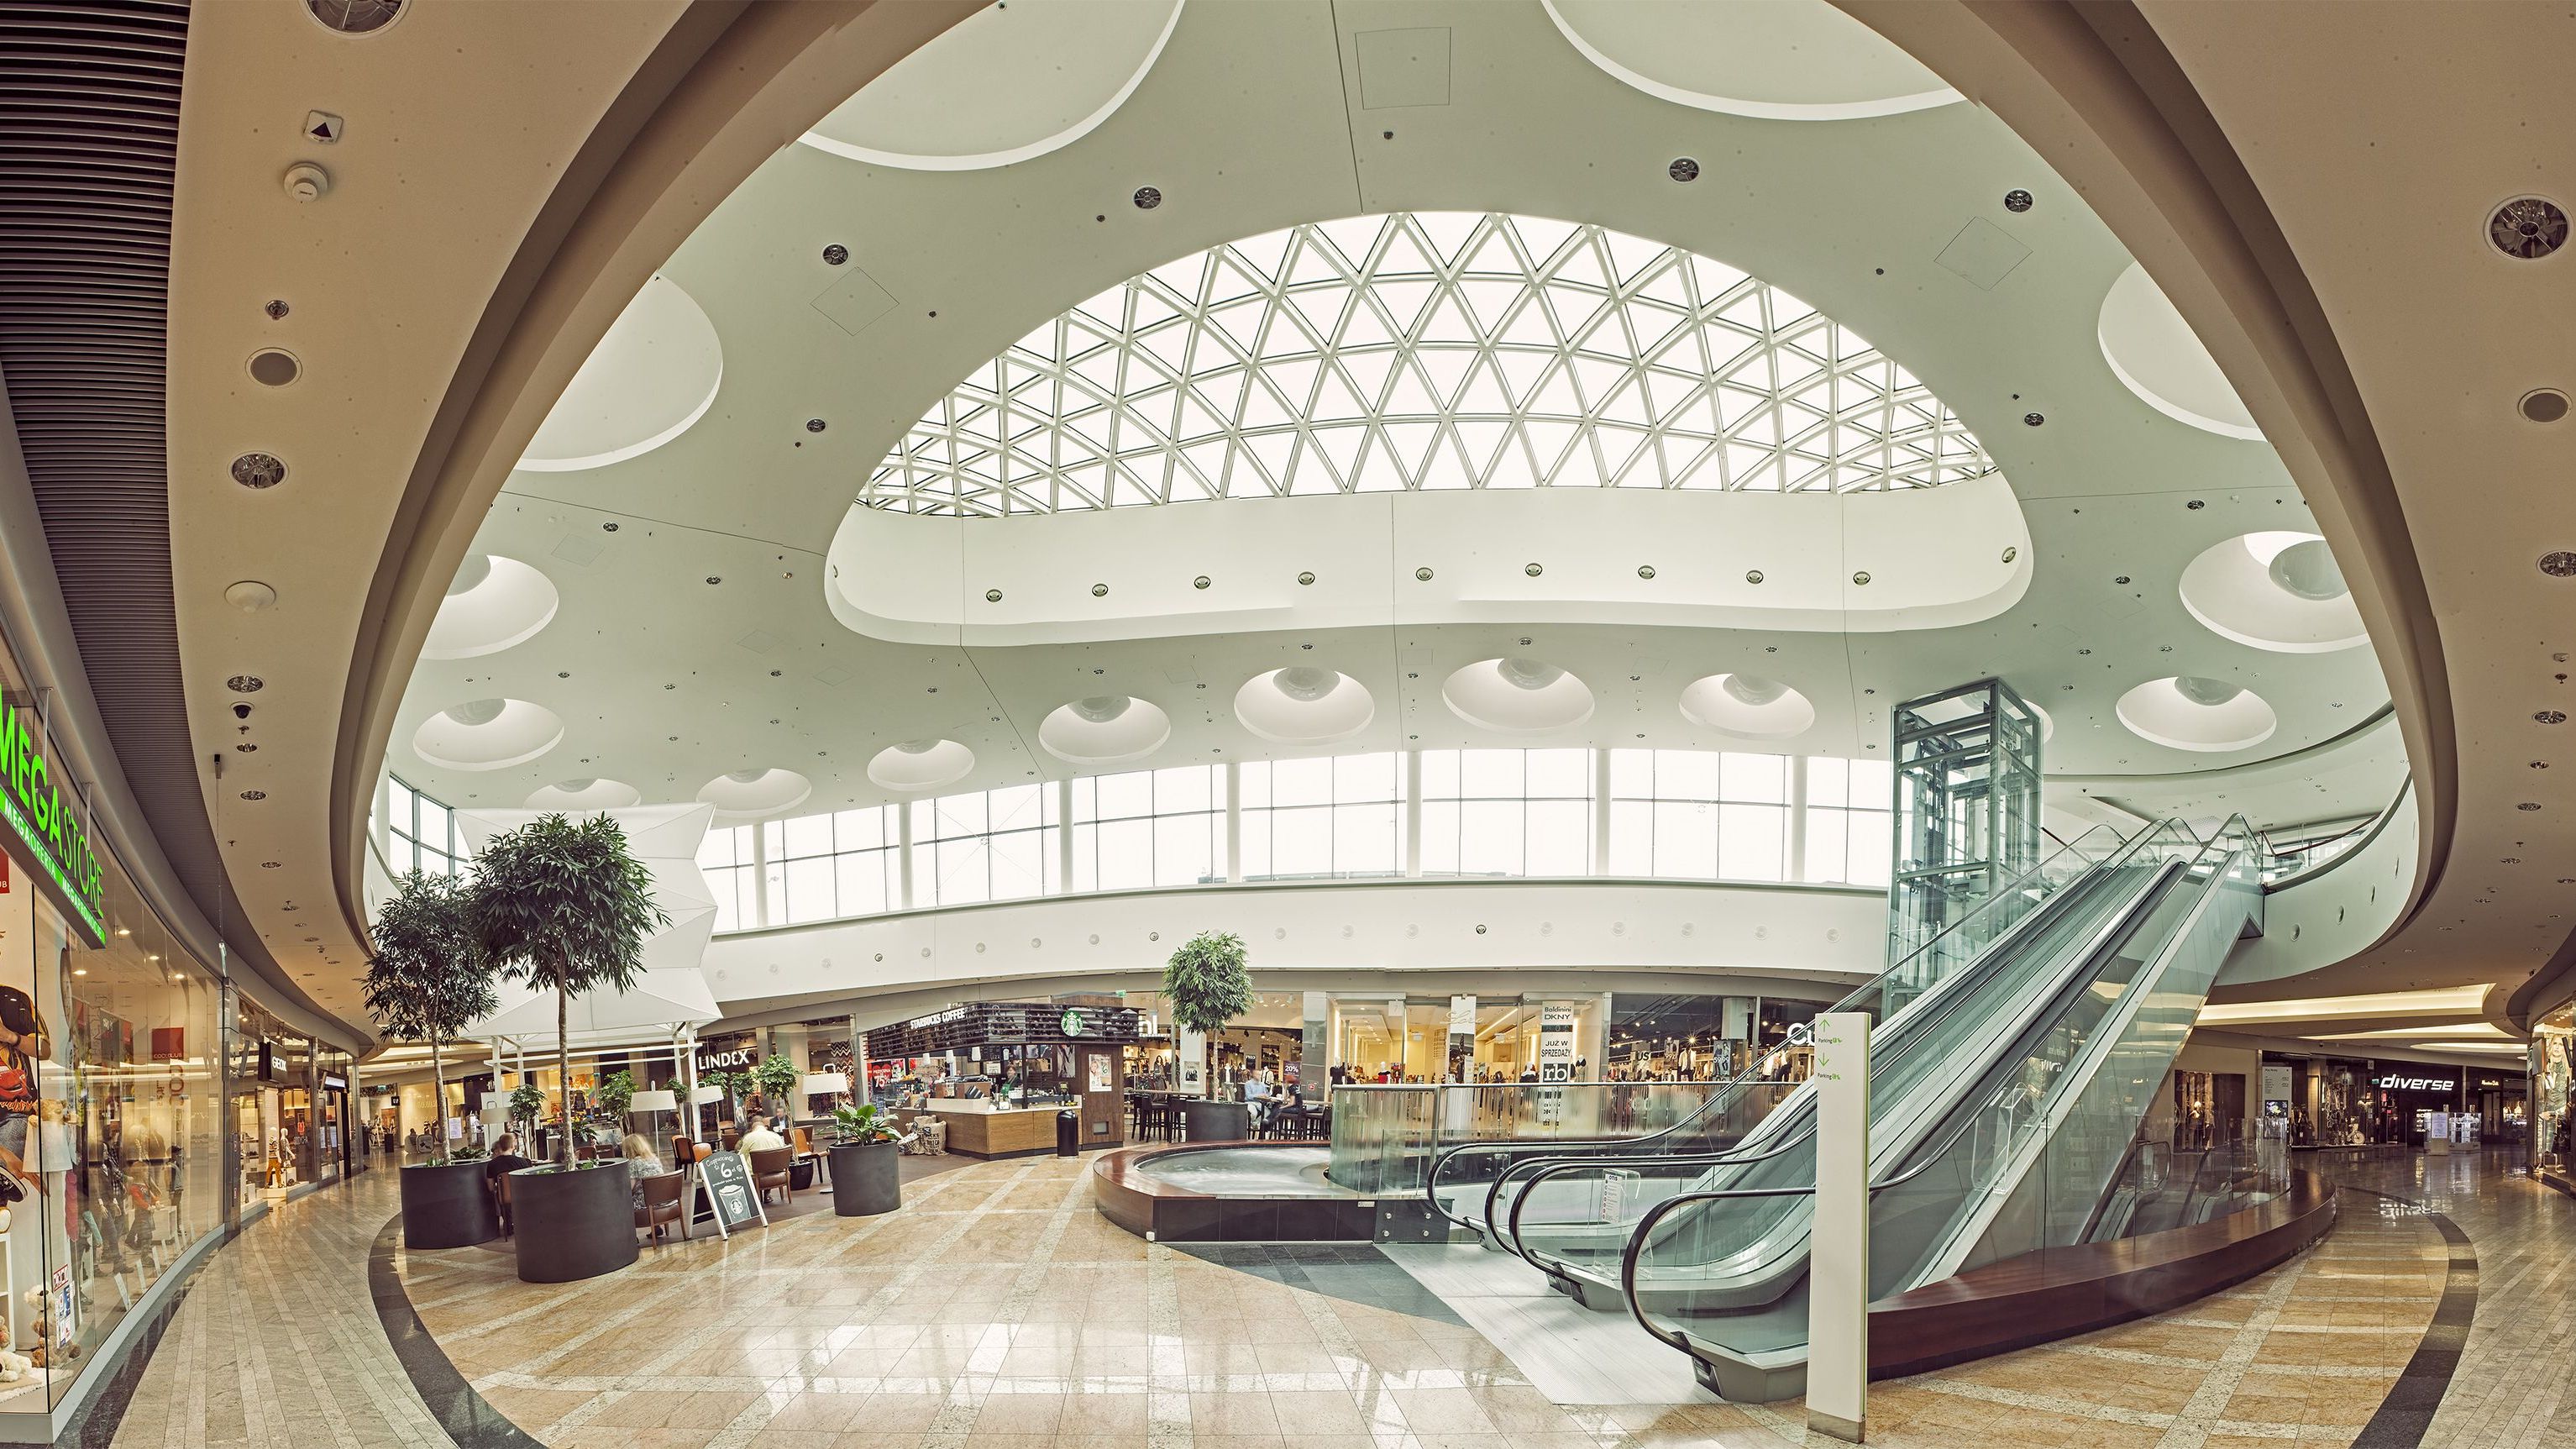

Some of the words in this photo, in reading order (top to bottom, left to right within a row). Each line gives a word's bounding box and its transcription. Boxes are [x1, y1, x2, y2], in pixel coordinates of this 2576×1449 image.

[4, 796, 57, 881] MEGAOFERTA
[910, 1013, 942, 1030] STARBUCKS
[942, 1007, 966, 1024] COFFEE
[1786, 1022, 1815, 1047] Cu
[698, 1049, 750, 1070] LINDEX
[1541, 1047, 1571, 1058] SPRZEDAŻY
[272, 1056, 286, 1072] GEOX
[1544, 1064, 1567, 1081] rb
[2380, 1074, 2454, 1090] diverse
[721, 1163, 732, 1179] 6
